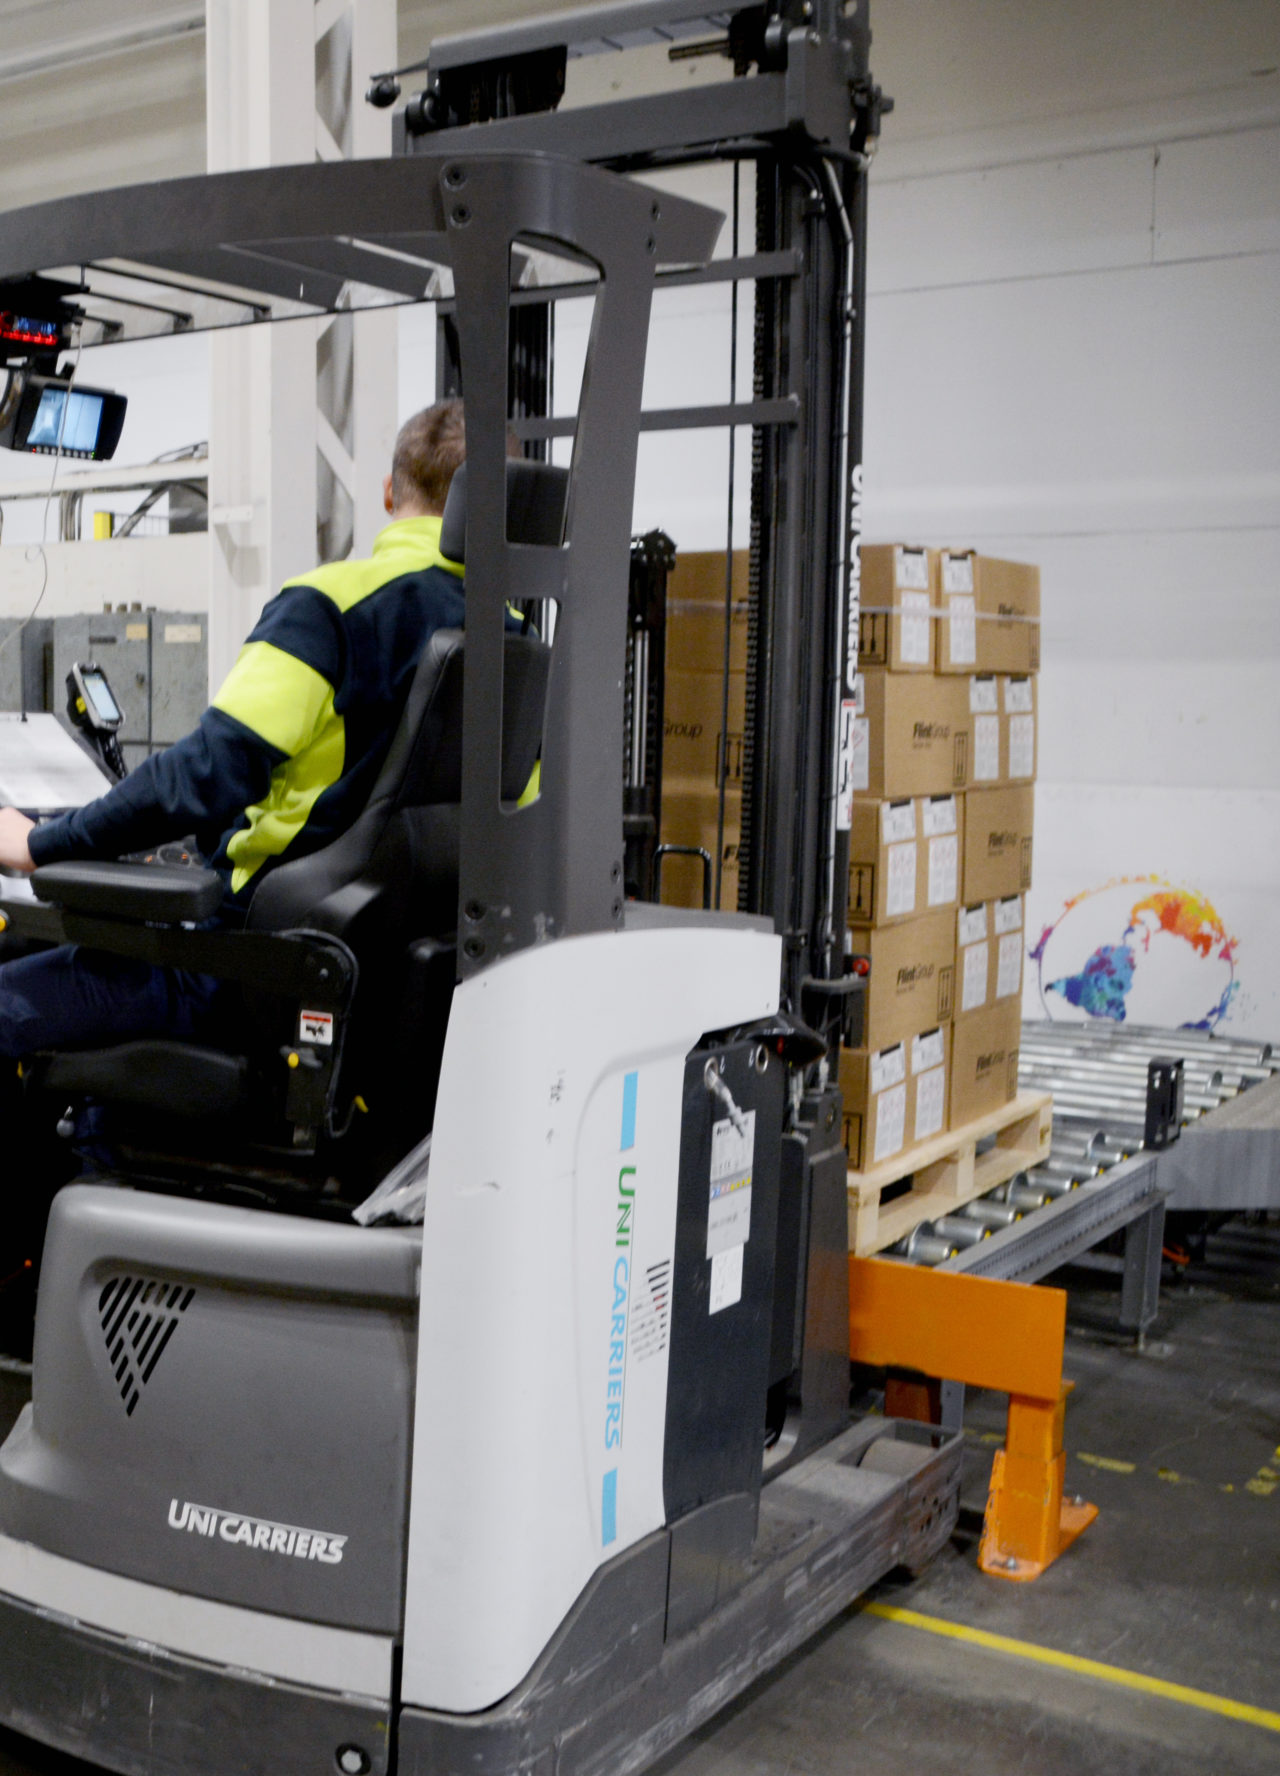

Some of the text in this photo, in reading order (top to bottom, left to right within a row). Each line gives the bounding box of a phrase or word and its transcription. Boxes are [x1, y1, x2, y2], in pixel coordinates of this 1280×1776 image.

[604, 1165, 636, 1450] UNI CARRIERS
[168, 1498, 347, 1564] UNI CARRIERS
